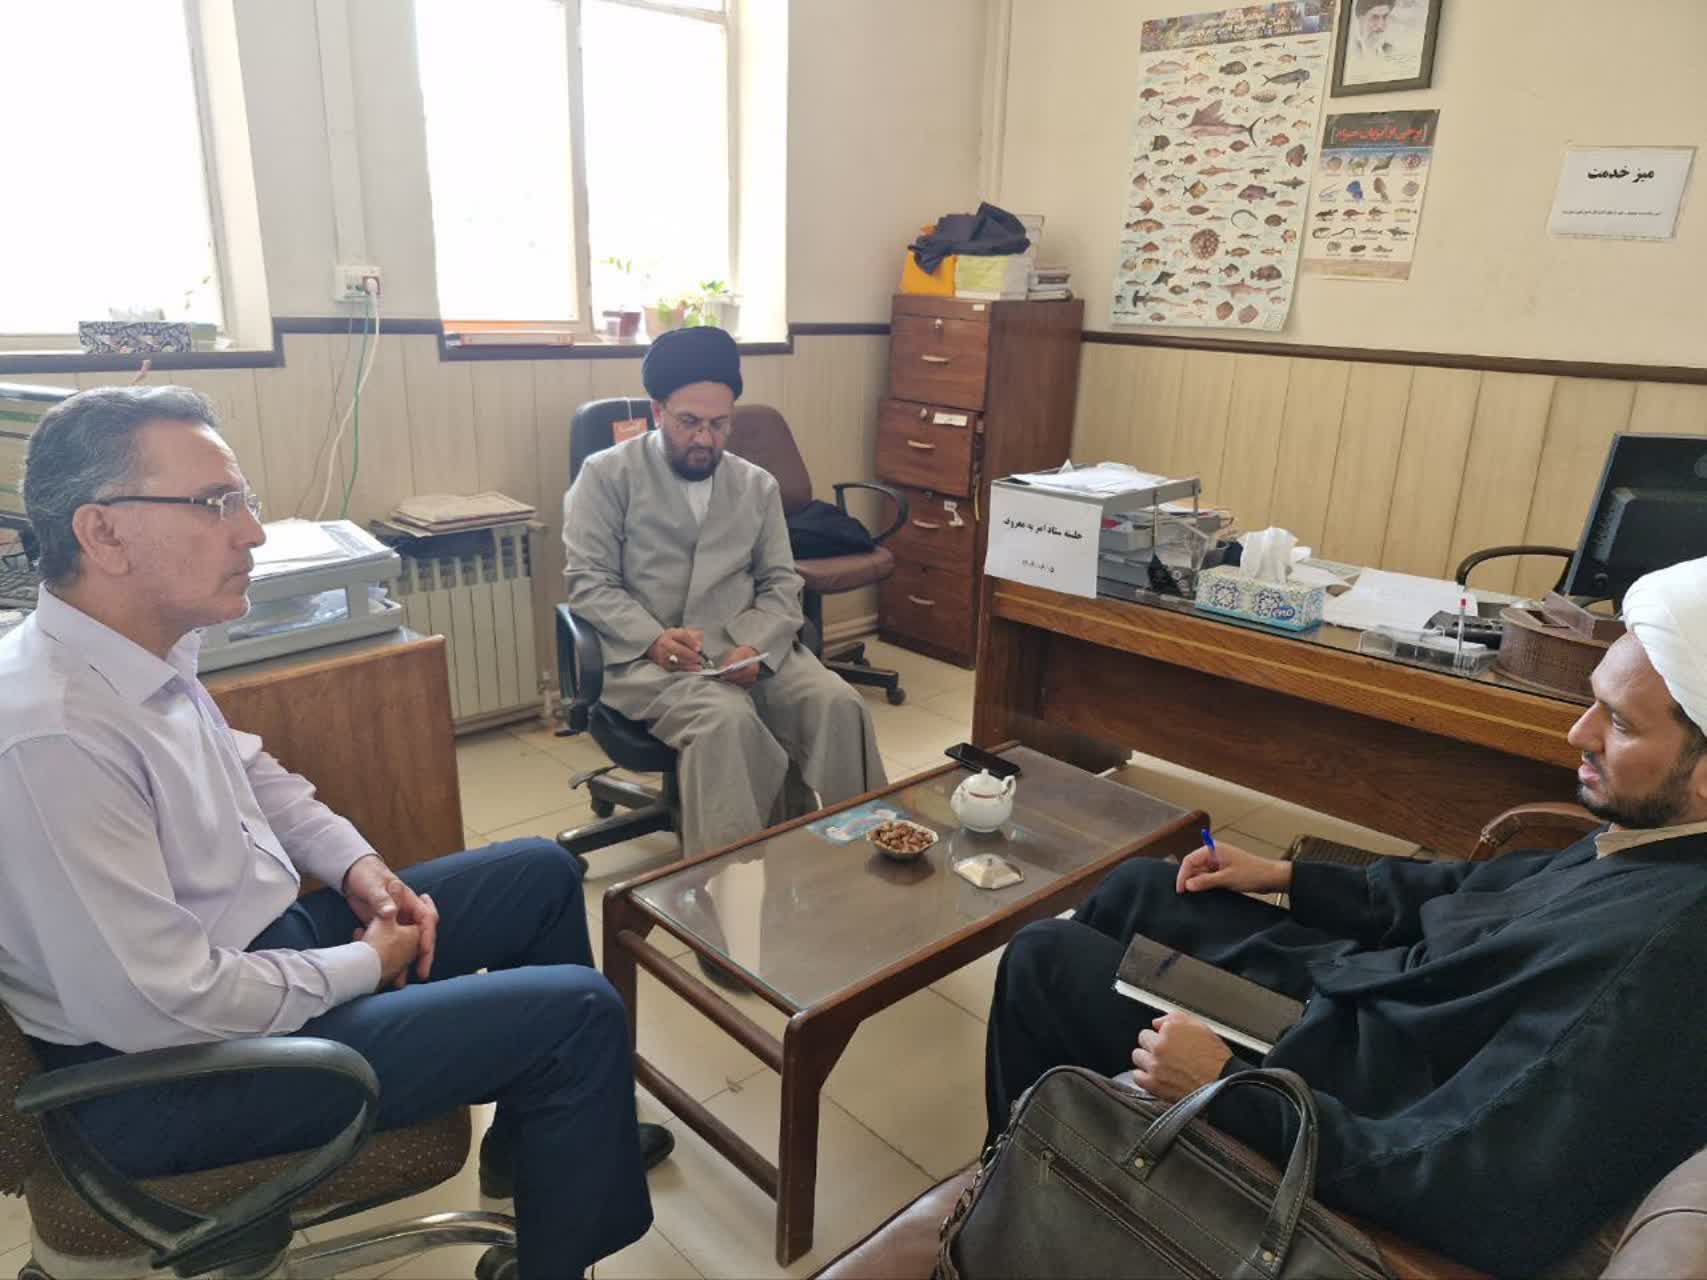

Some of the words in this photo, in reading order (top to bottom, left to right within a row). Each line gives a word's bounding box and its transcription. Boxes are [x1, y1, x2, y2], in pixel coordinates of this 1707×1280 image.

[1587, 164, 1630, 180] خدمت
[1631, 167, 1655, 183] میز
[1003, 516, 1025, 529] معروف
[1026, 521, 1035, 531] به
[1035, 523, 1047, 534] امر
[1047, 525, 1063, 536] ستاد
